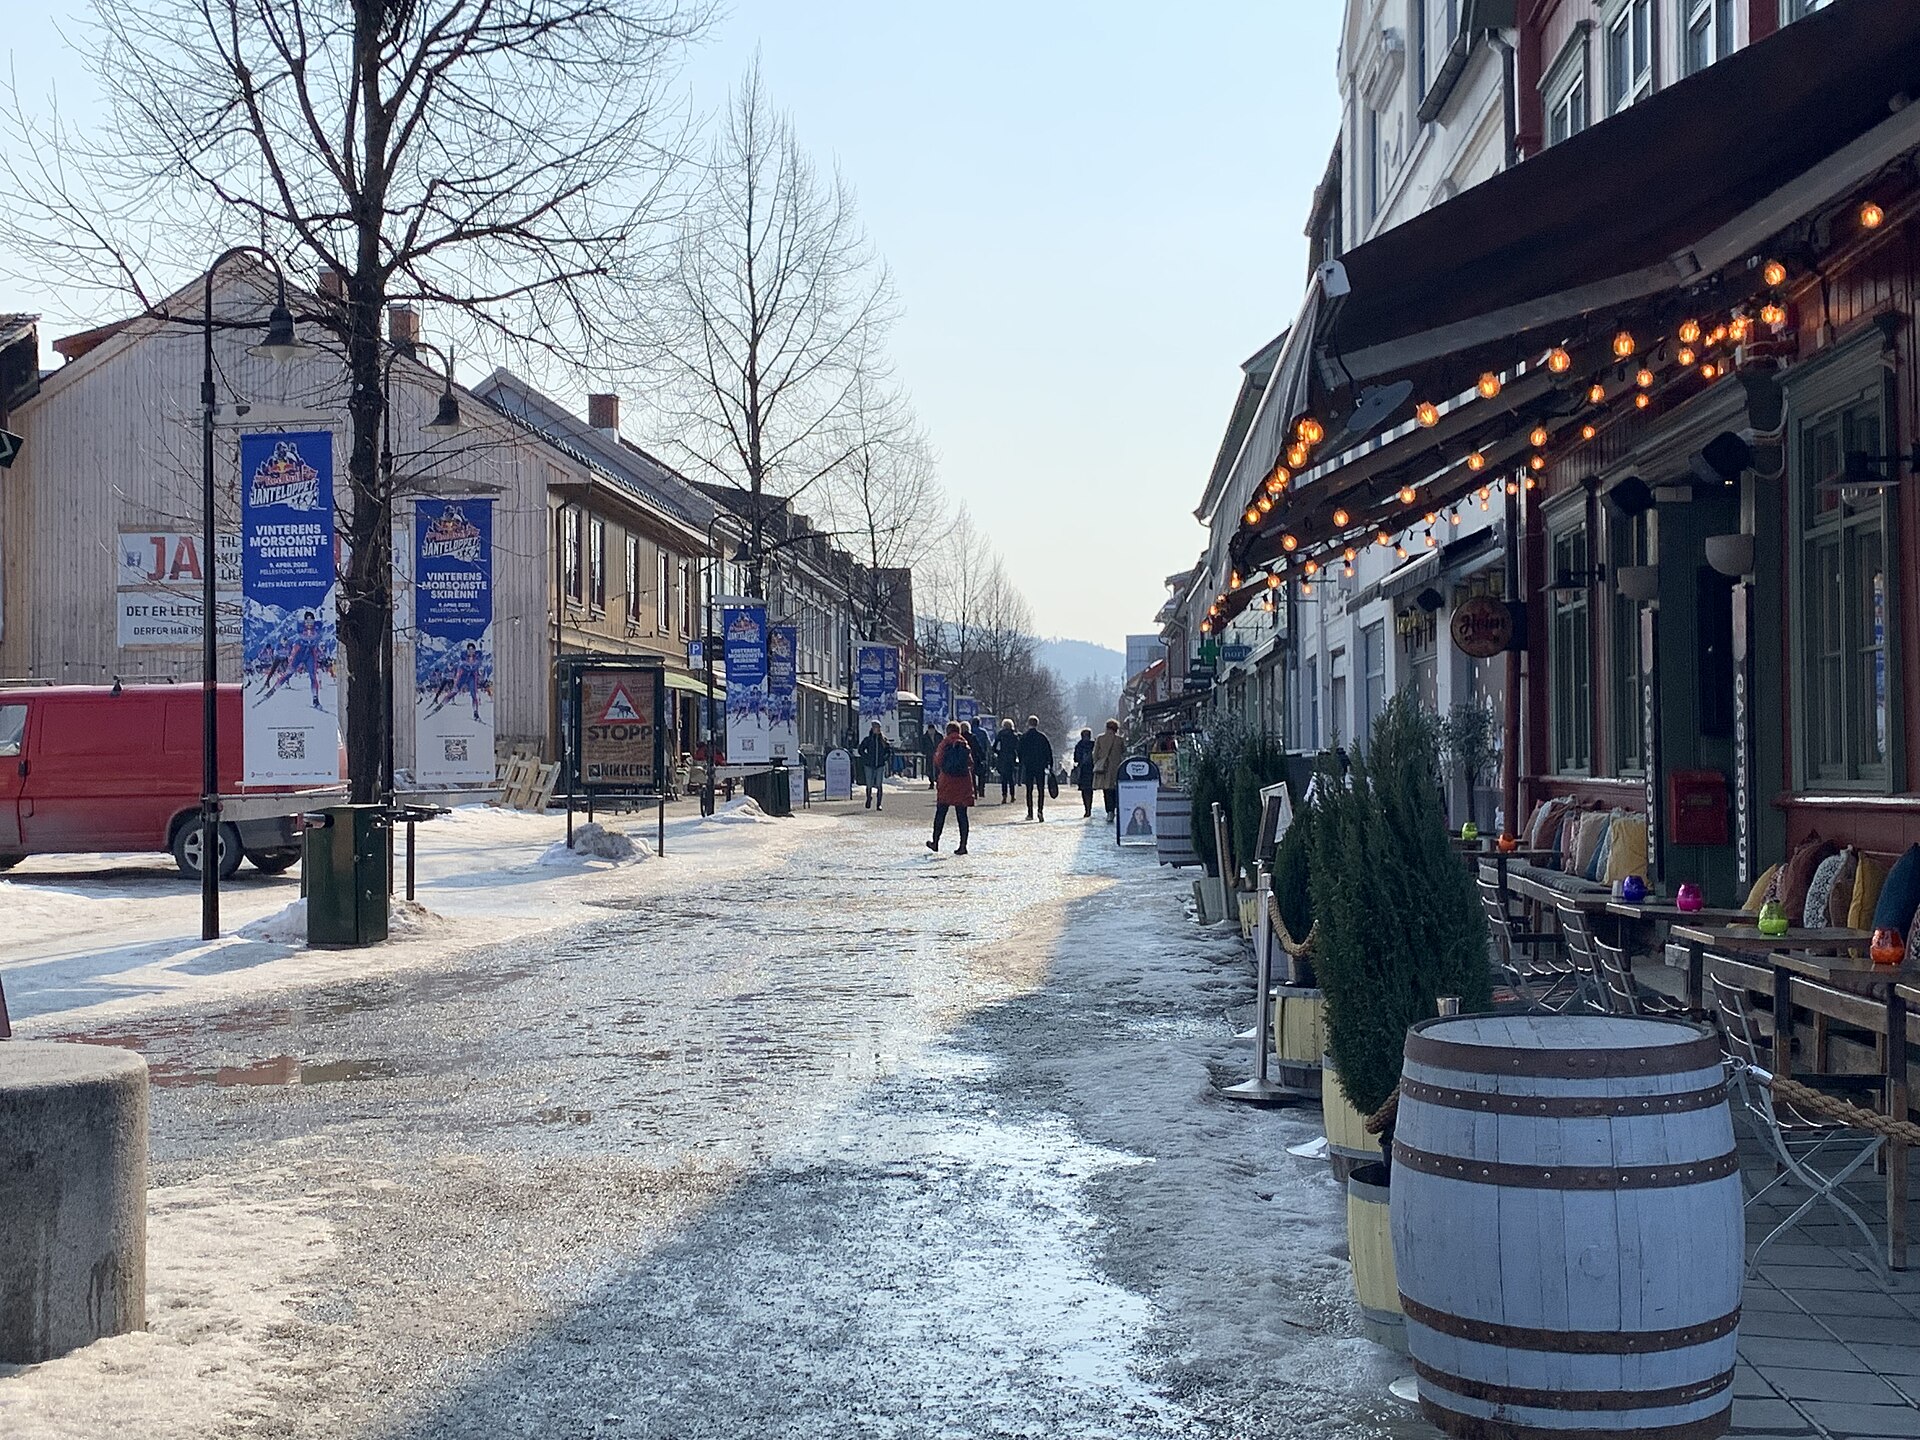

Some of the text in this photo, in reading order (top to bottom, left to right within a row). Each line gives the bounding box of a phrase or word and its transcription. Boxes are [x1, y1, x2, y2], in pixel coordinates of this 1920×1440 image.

[250, 479, 316, 505] JANTELOPPET
[255, 523, 321, 535] VINTERENS
[249, 535, 328, 547] MORSOMSTE
[422, 537, 479, 557] JANTELOPPET
[147, 536, 204, 580] JA
[260, 546, 317, 558] SKIRENN!
[426, 572, 482, 581] VINTERENS
[422, 581, 487, 590] MORSOMSTE
[430, 590, 478, 599] SKIRENN!
[126, 605, 149, 617] DET
[152, 605, 167, 617] ER
[133, 626, 169, 636] DERFOR
[171, 626, 189, 636] HAR
[692, 644, 700, 655] P
[587, 725, 652, 740] STOPP
[601, 763, 651, 777] NIKKERS
[1735, 673, 1747, 883] GASTROPUB
